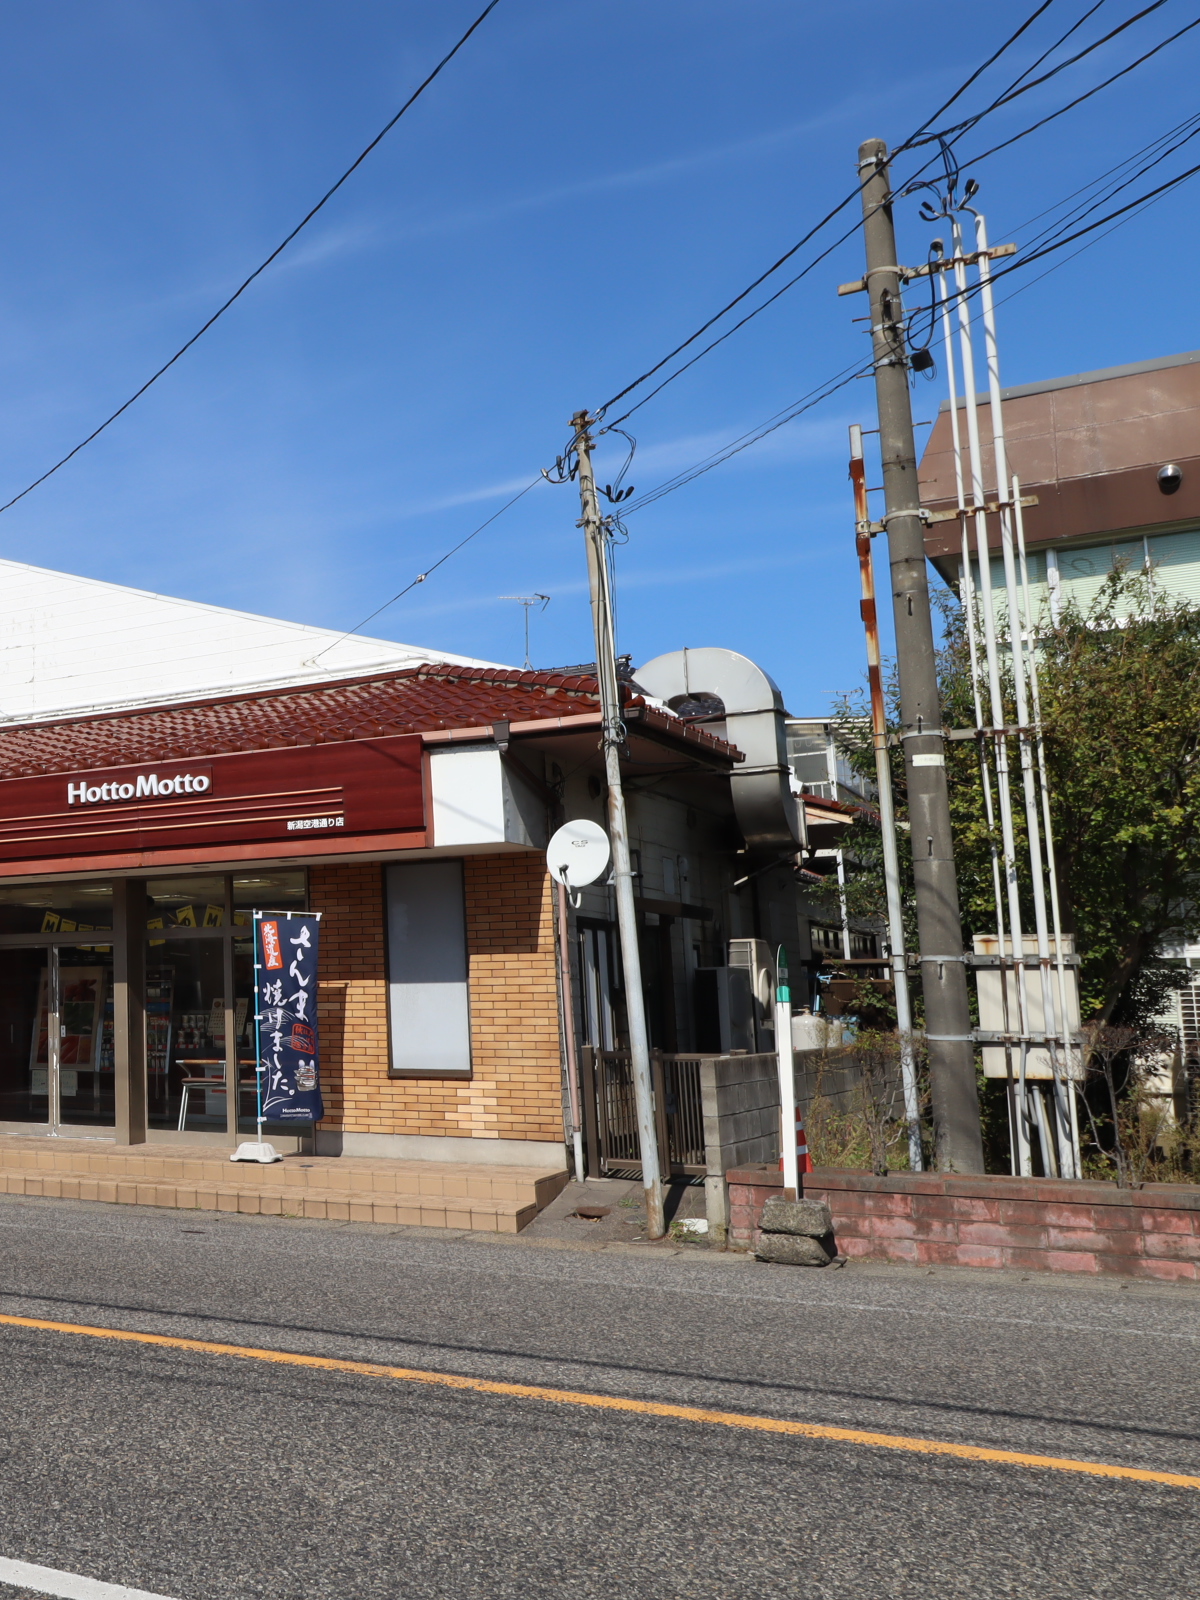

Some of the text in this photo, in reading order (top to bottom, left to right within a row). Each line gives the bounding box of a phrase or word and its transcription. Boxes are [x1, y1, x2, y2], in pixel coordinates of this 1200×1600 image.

[287, 817, 344, 830] 新潟空港通り店
[264, 923, 278, 967] 北海道産
[288, 925, 311, 1022] さんま
